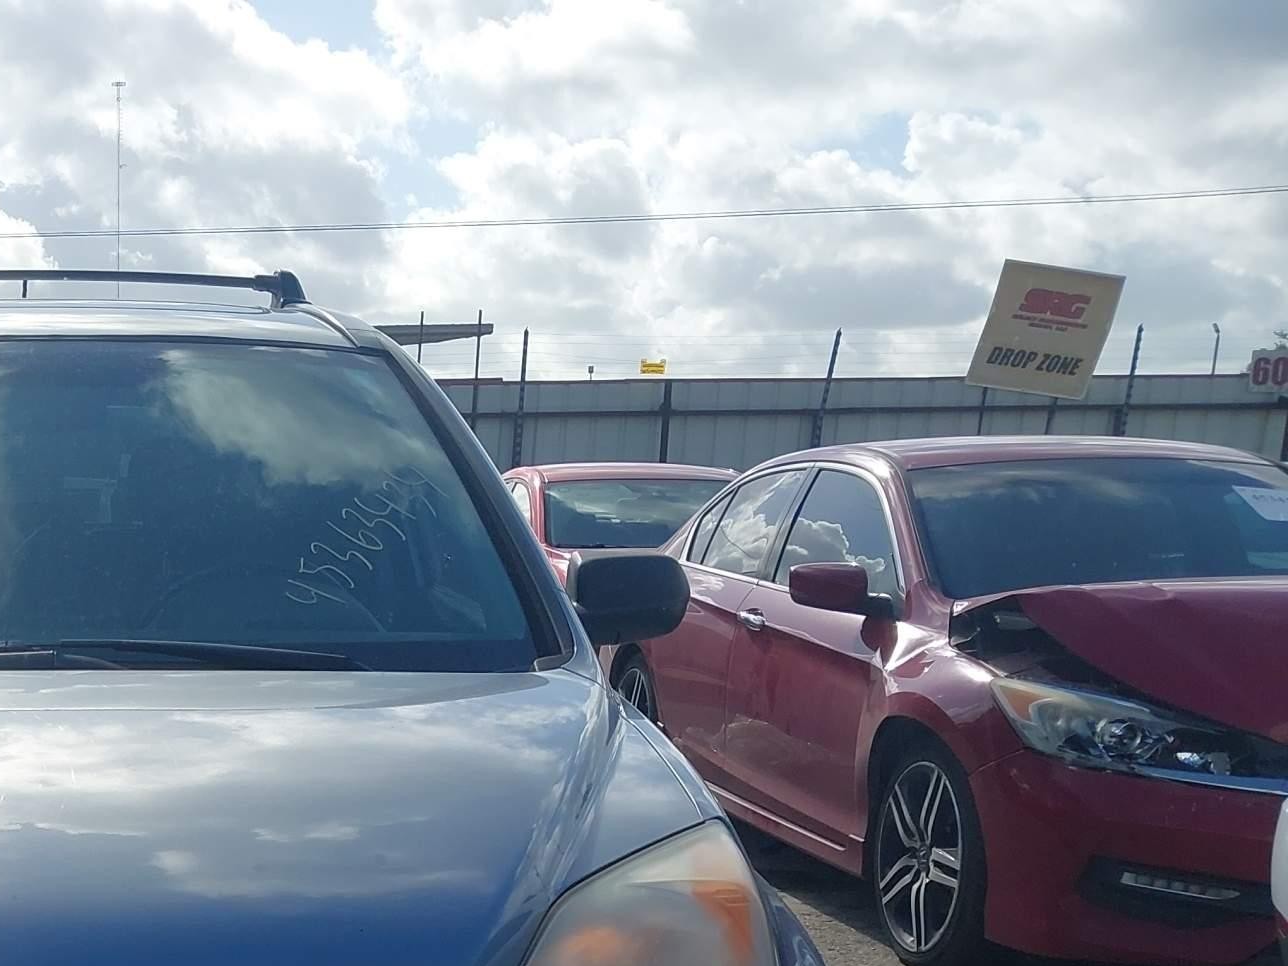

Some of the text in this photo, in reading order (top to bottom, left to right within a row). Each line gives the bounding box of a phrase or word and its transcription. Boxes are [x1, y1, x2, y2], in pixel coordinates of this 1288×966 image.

[985, 346, 1084, 376] DROP ZONE
[1252, 356, 1288, 386] 60
[285, 466, 451, 604] 45363434
